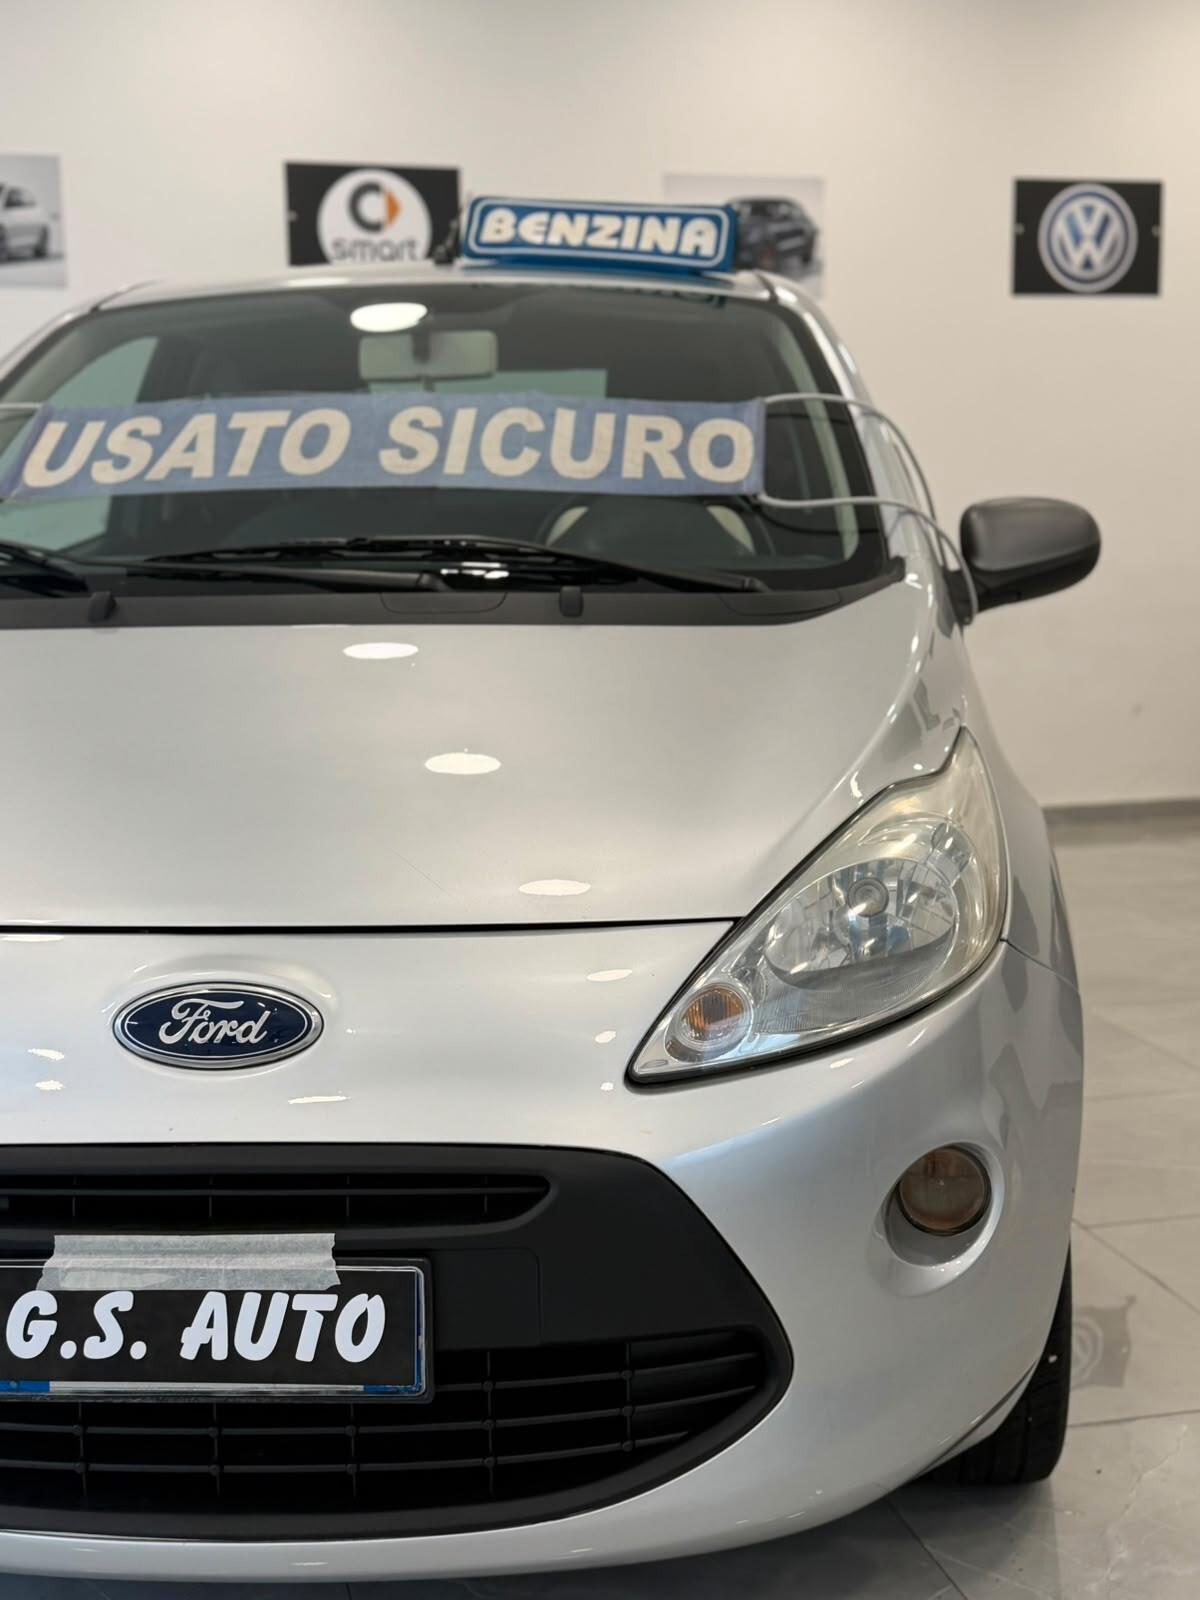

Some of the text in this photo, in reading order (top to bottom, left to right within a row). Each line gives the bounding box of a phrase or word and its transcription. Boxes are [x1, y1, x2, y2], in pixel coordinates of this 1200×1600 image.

[331, 238, 418, 262] smart
[479, 207, 719, 258] BENZINA
[21, 406, 755, 489] USATO SICURO
[158, 998, 272, 1045] Ford
[5, 1289, 387, 1364] G.S. AUTO
